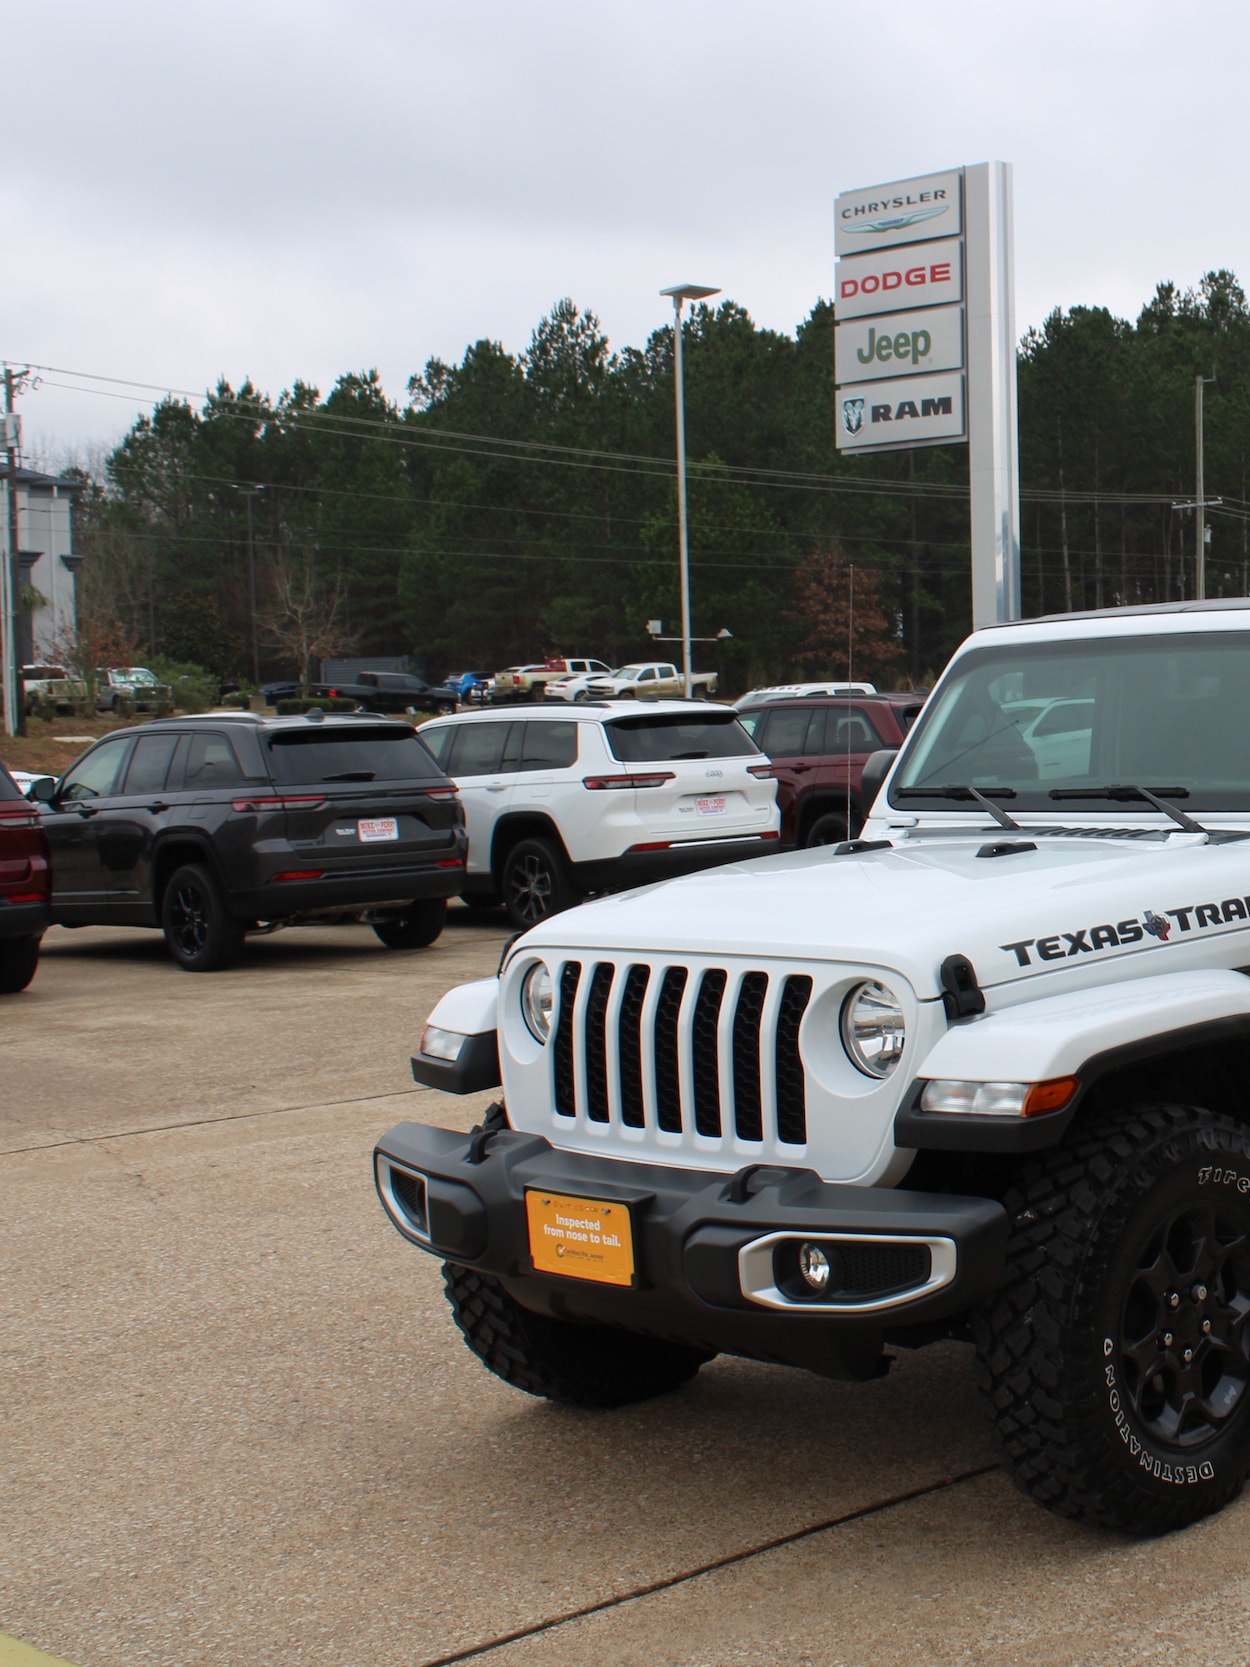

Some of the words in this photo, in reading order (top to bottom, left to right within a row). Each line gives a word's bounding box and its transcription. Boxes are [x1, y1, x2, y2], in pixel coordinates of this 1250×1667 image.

[841, 189, 947, 219] CHRYSLER
[841, 263, 951, 299] DODGE
[857, 328, 932, 365] Jeep
[871, 396, 952, 423] RAM
[998, 918, 1144, 967] TEXAS
[544, 1224, 564, 1238] from
[566, 1231, 588, 1242] nose
[590, 1233, 600, 1244] to
[602, 1234, 621, 1247] tail.
[556, 1213, 600, 1231] Inspected
[1105, 1364, 1214, 1484] DESTINATION
